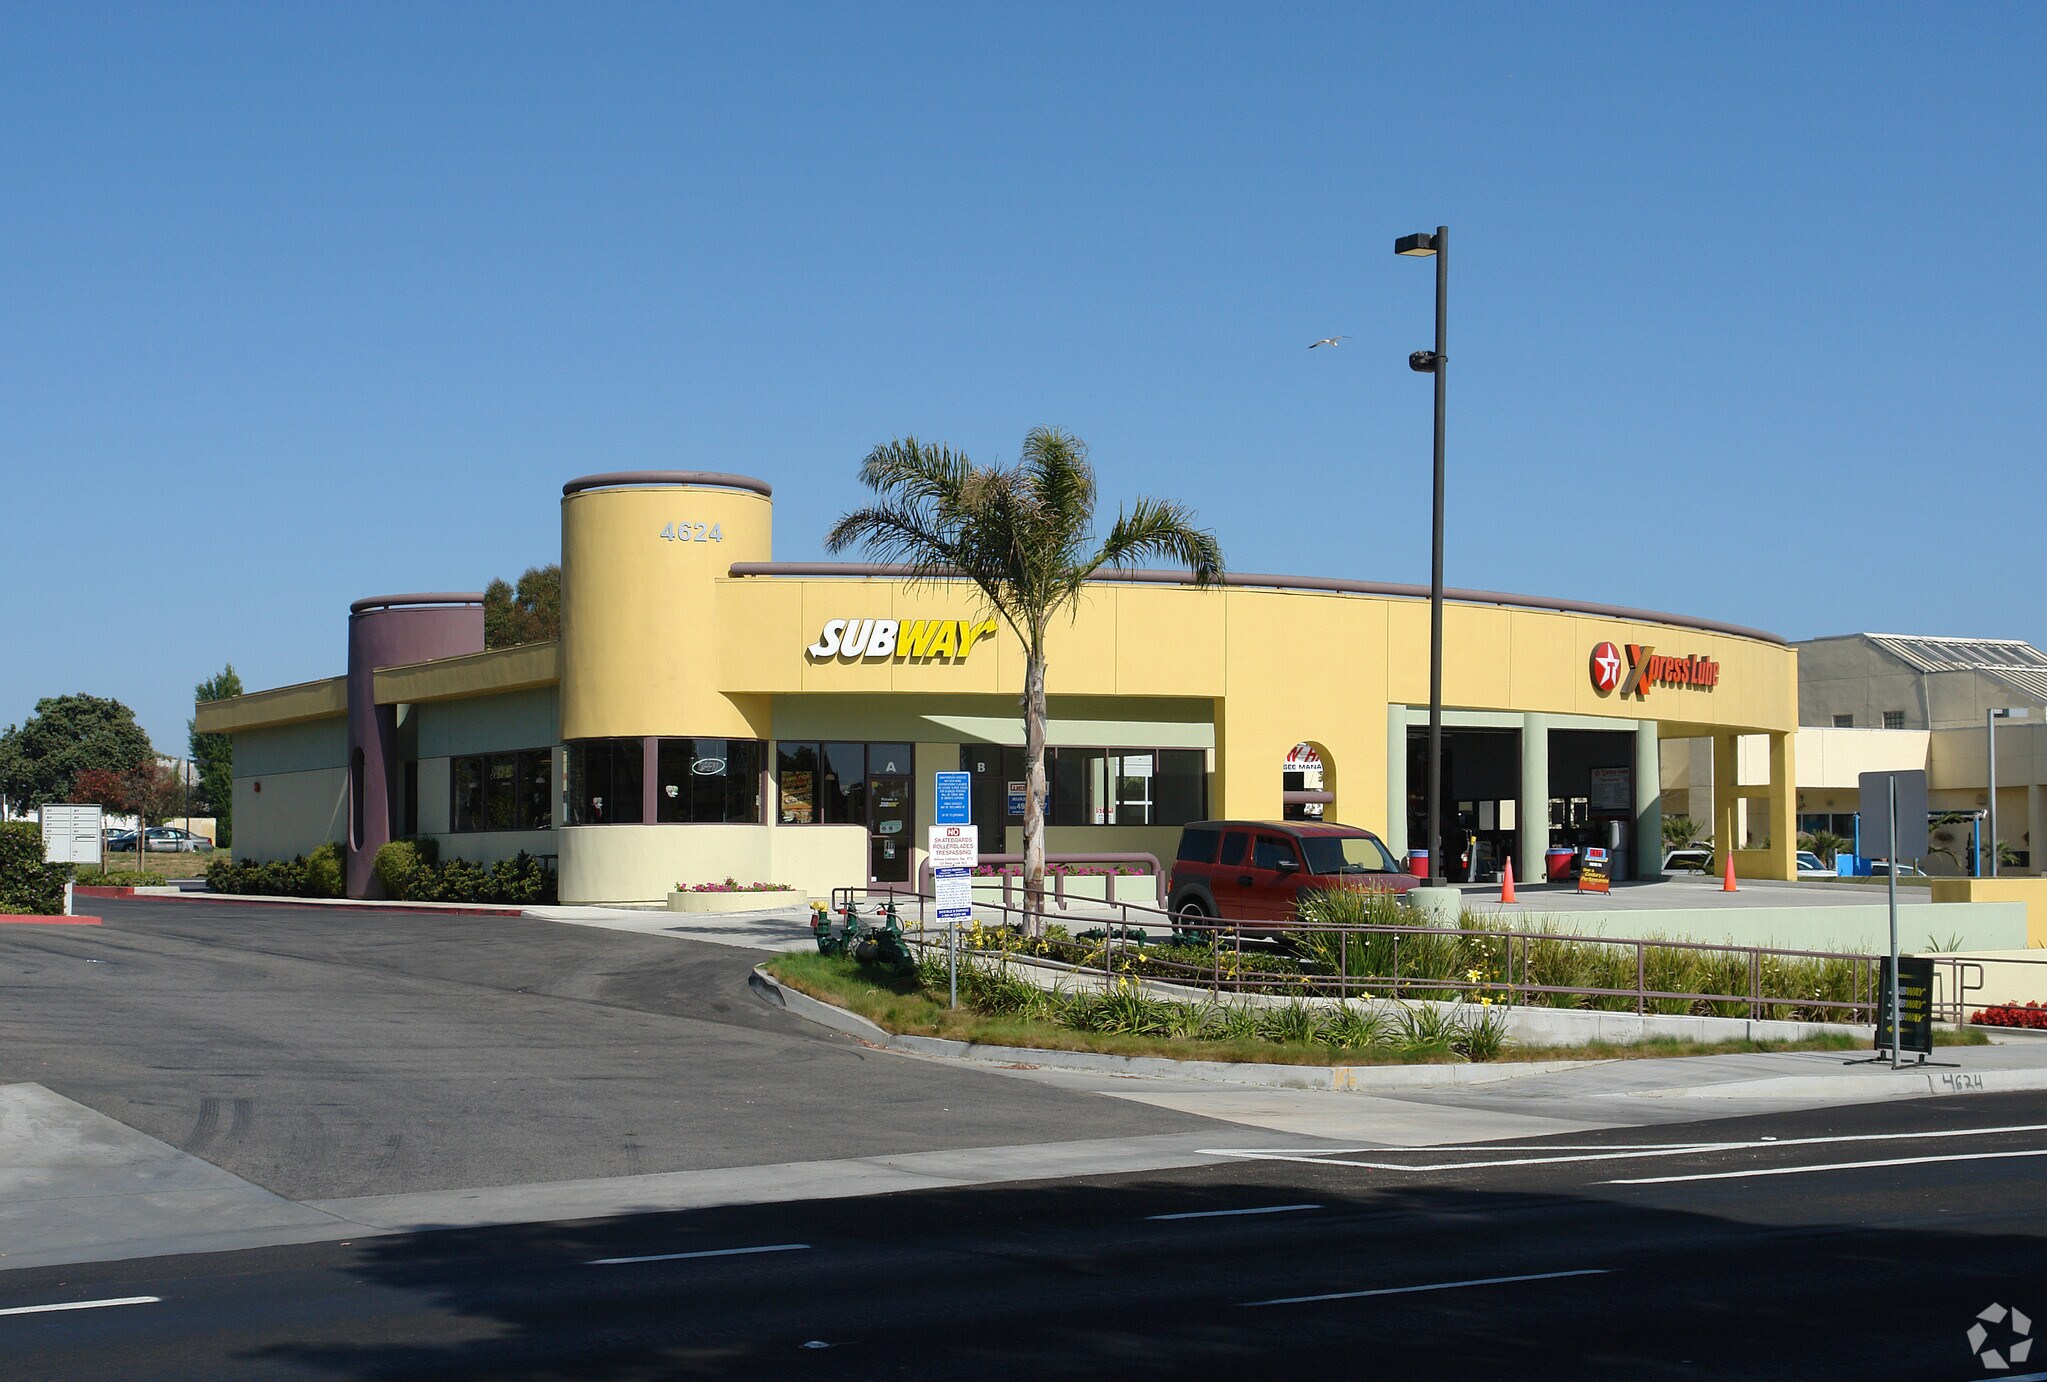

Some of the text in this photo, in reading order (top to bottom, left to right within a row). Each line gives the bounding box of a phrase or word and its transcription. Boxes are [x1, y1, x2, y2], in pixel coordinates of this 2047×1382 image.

[660, 521, 723, 542] 4624
[804, 618, 998, 659] SUBWAY
[1620, 644, 1720, 695] Xpress Lube
[886, 762, 897, 773] A
[977, 762, 986, 773] B
[1942, 1073, 1984, 1092] 4624
